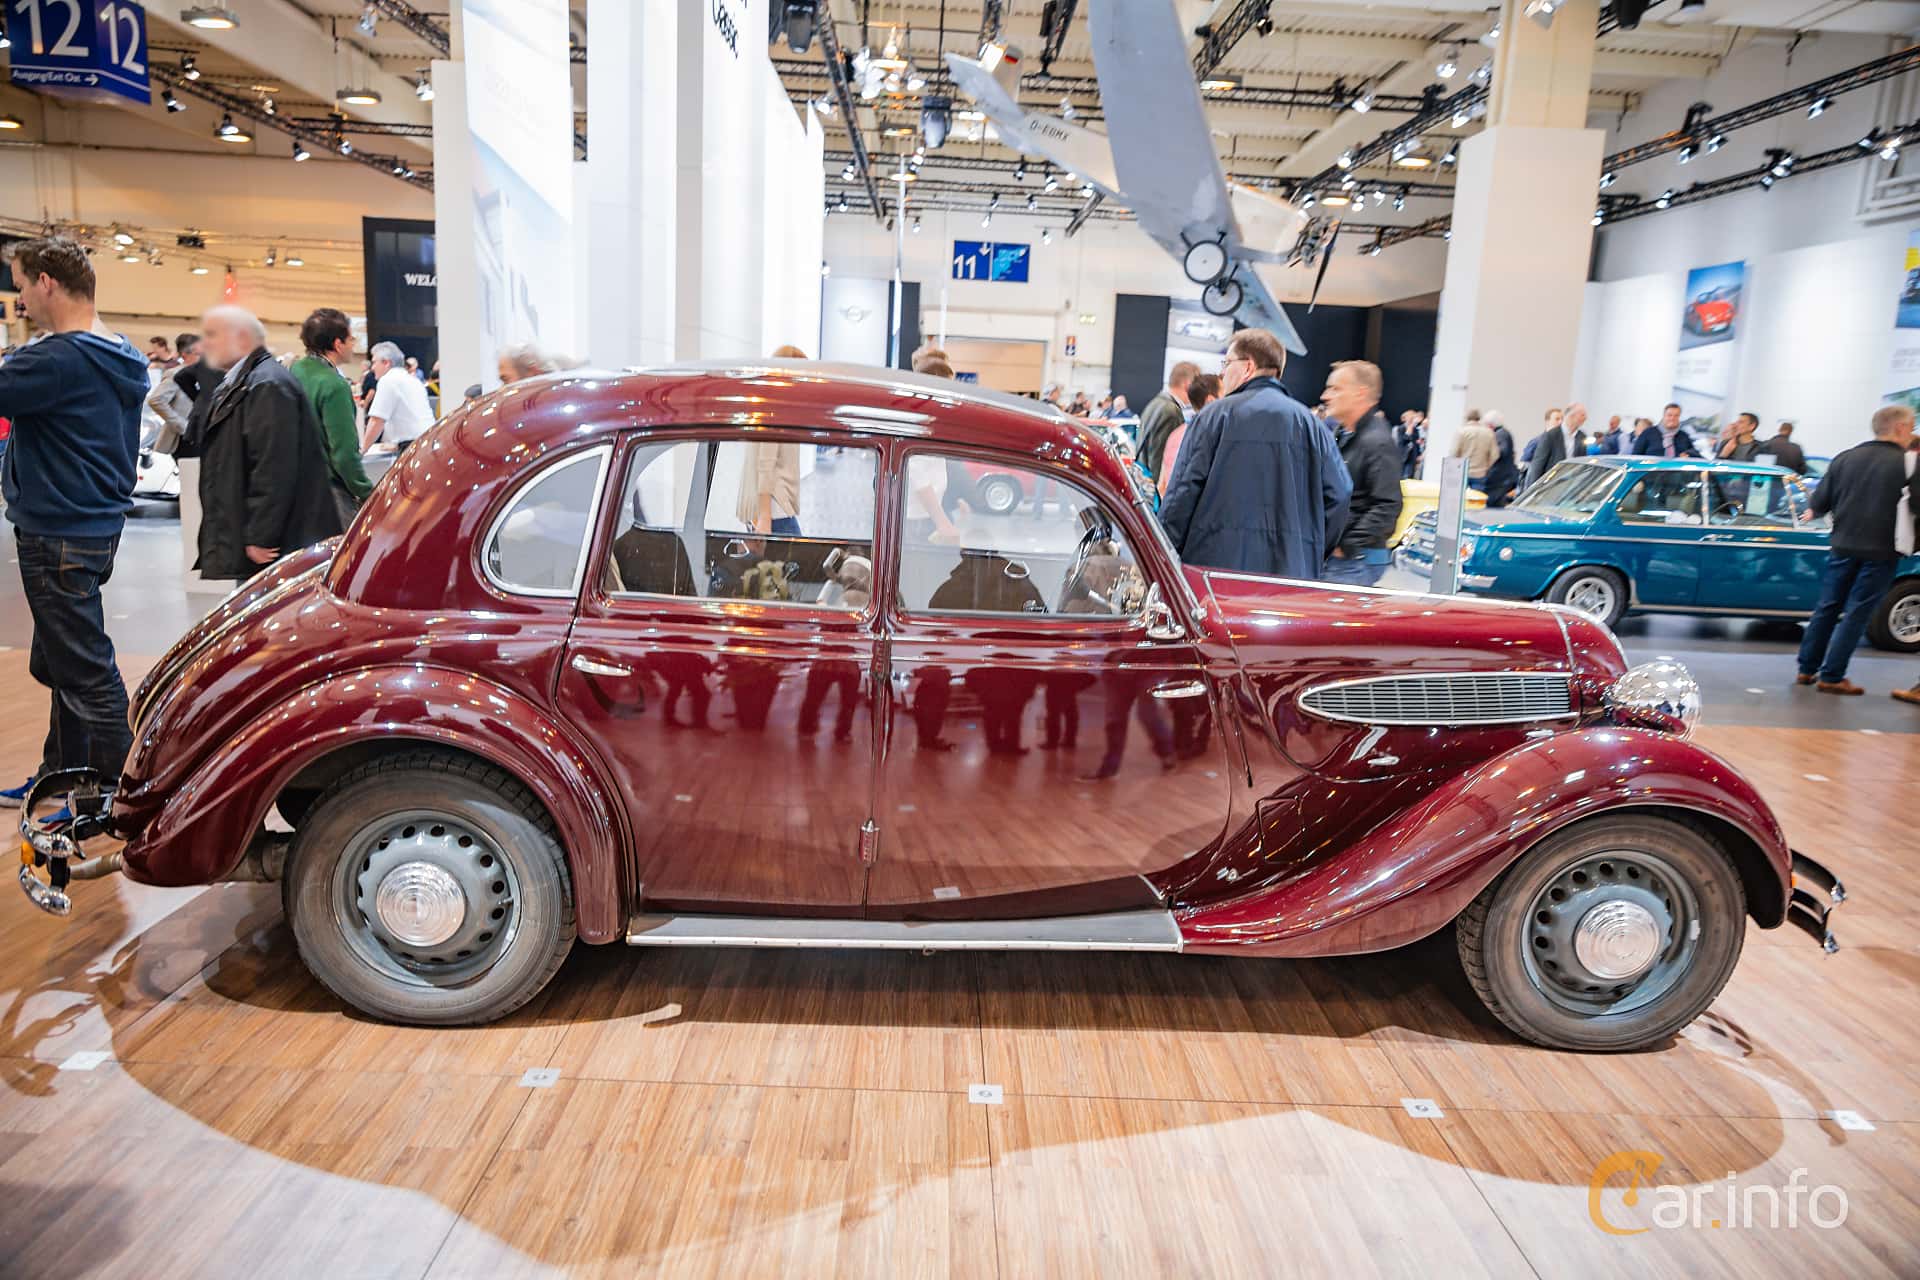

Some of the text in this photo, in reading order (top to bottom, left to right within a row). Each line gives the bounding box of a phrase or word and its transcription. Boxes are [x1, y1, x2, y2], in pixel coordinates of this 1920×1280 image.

[15, 0, 89, 57] 12
[100, 2, 145, 75] 12
[954, 253, 976, 280] 11
